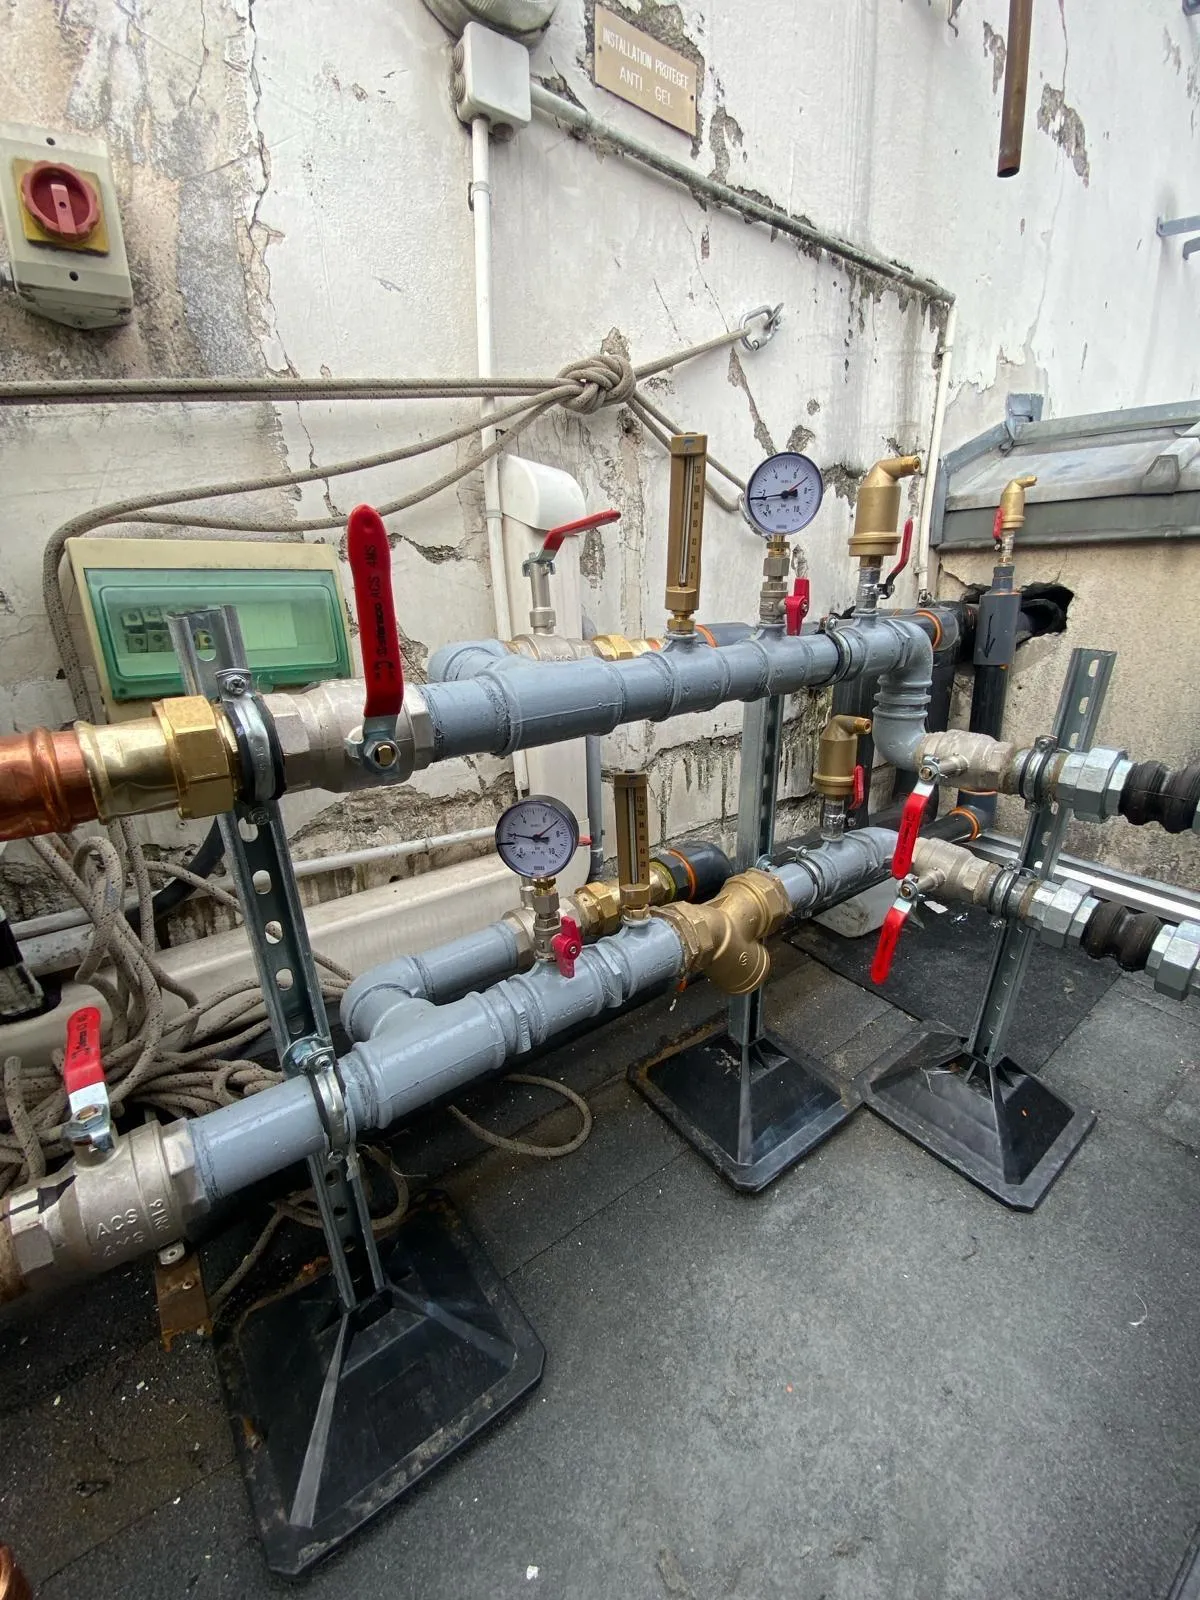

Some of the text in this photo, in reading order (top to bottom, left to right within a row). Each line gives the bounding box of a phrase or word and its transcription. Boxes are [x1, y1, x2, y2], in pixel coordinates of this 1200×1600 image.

[602, 28, 651, 70] INSTALLATION
[620, 66, 643, 92] ANTI
[96, 1208, 138, 1240] ACS
